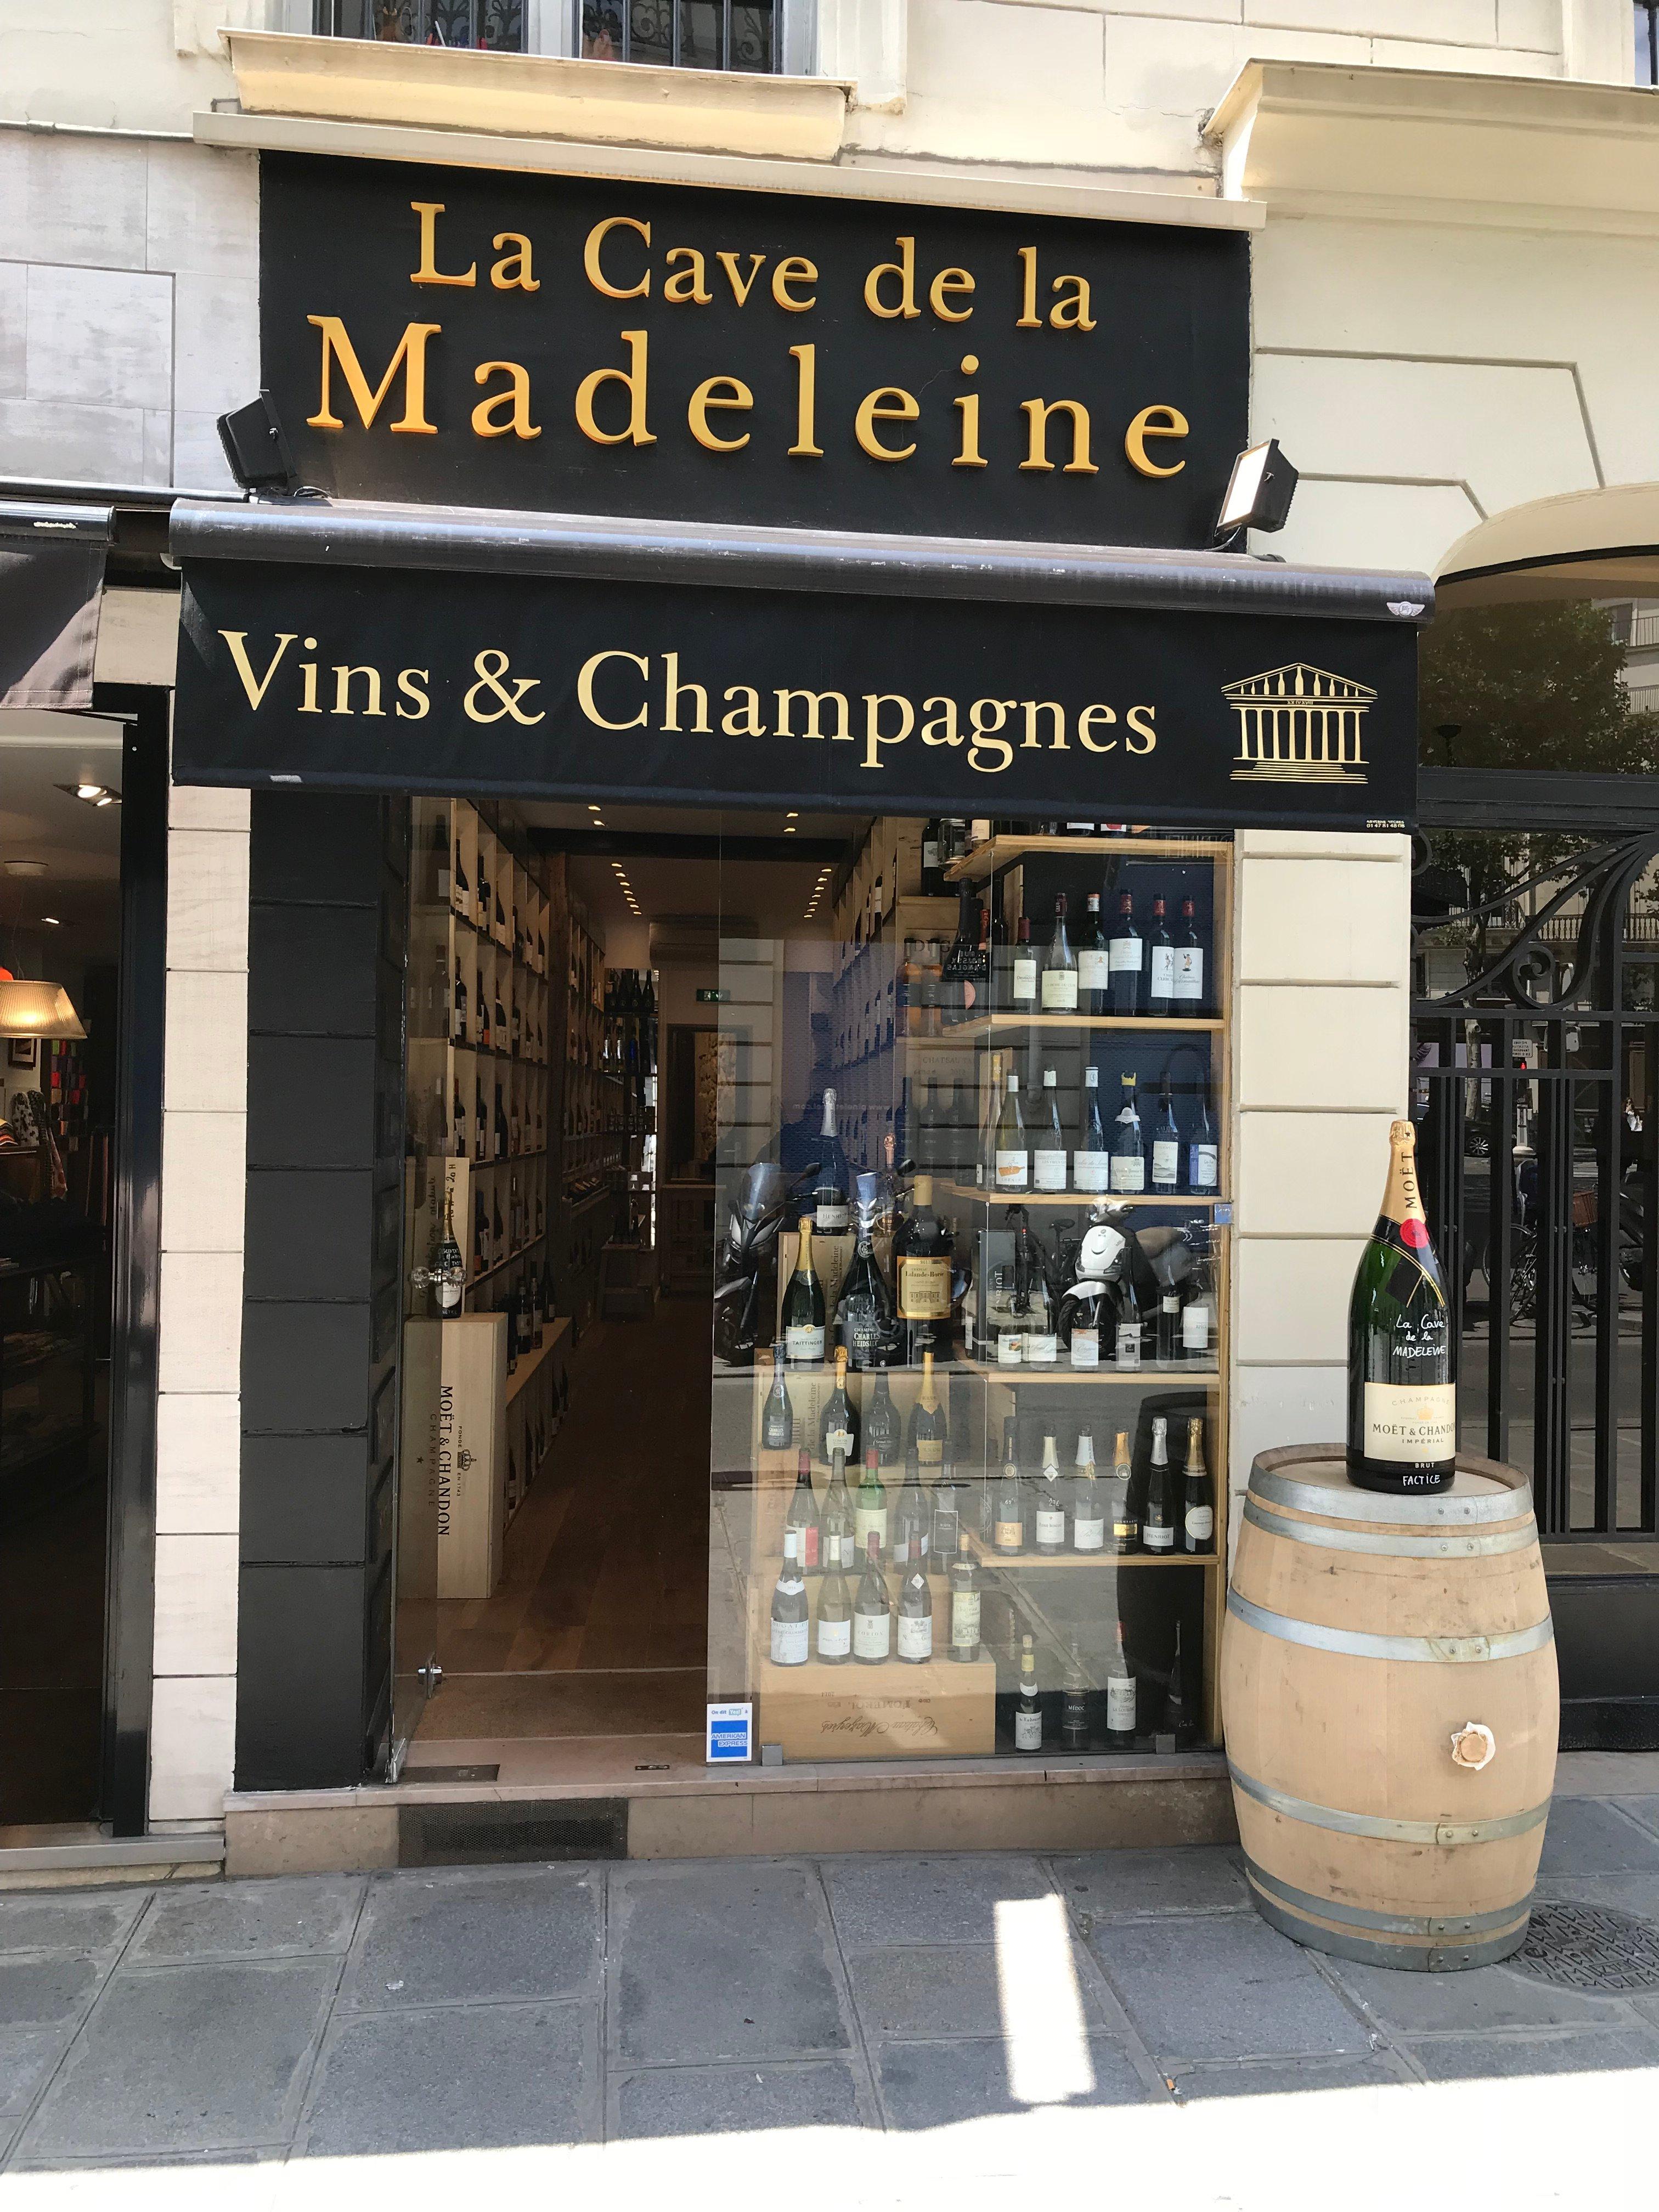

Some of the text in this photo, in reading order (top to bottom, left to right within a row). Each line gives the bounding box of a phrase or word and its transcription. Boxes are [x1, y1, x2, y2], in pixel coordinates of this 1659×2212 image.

[410, 202, 1096, 331] La Cave de la
[307, 315, 1188, 477] Madeleine
[218, 630, 1156, 772] Vins & Champagnes
[1399, 1152, 1415, 1209] MOËT
[830, 1245, 839, 1288] Madeleine
[1396, 1314, 1445, 1329] La Cave
[1406, 1331, 1434, 1341] de la
[808, 1382, 817, 1427] Madeleine
[1392, 1397, 1450, 1406] CHAMPAGNE
[1373, 1423, 1407, 1435] MOËT
[1409, 1427, 1416, 1436] &
[428, 1413, 437, 1507] CHAMPAGNE
[437, 1385, 455, 1537] MOËT & CHANDON
